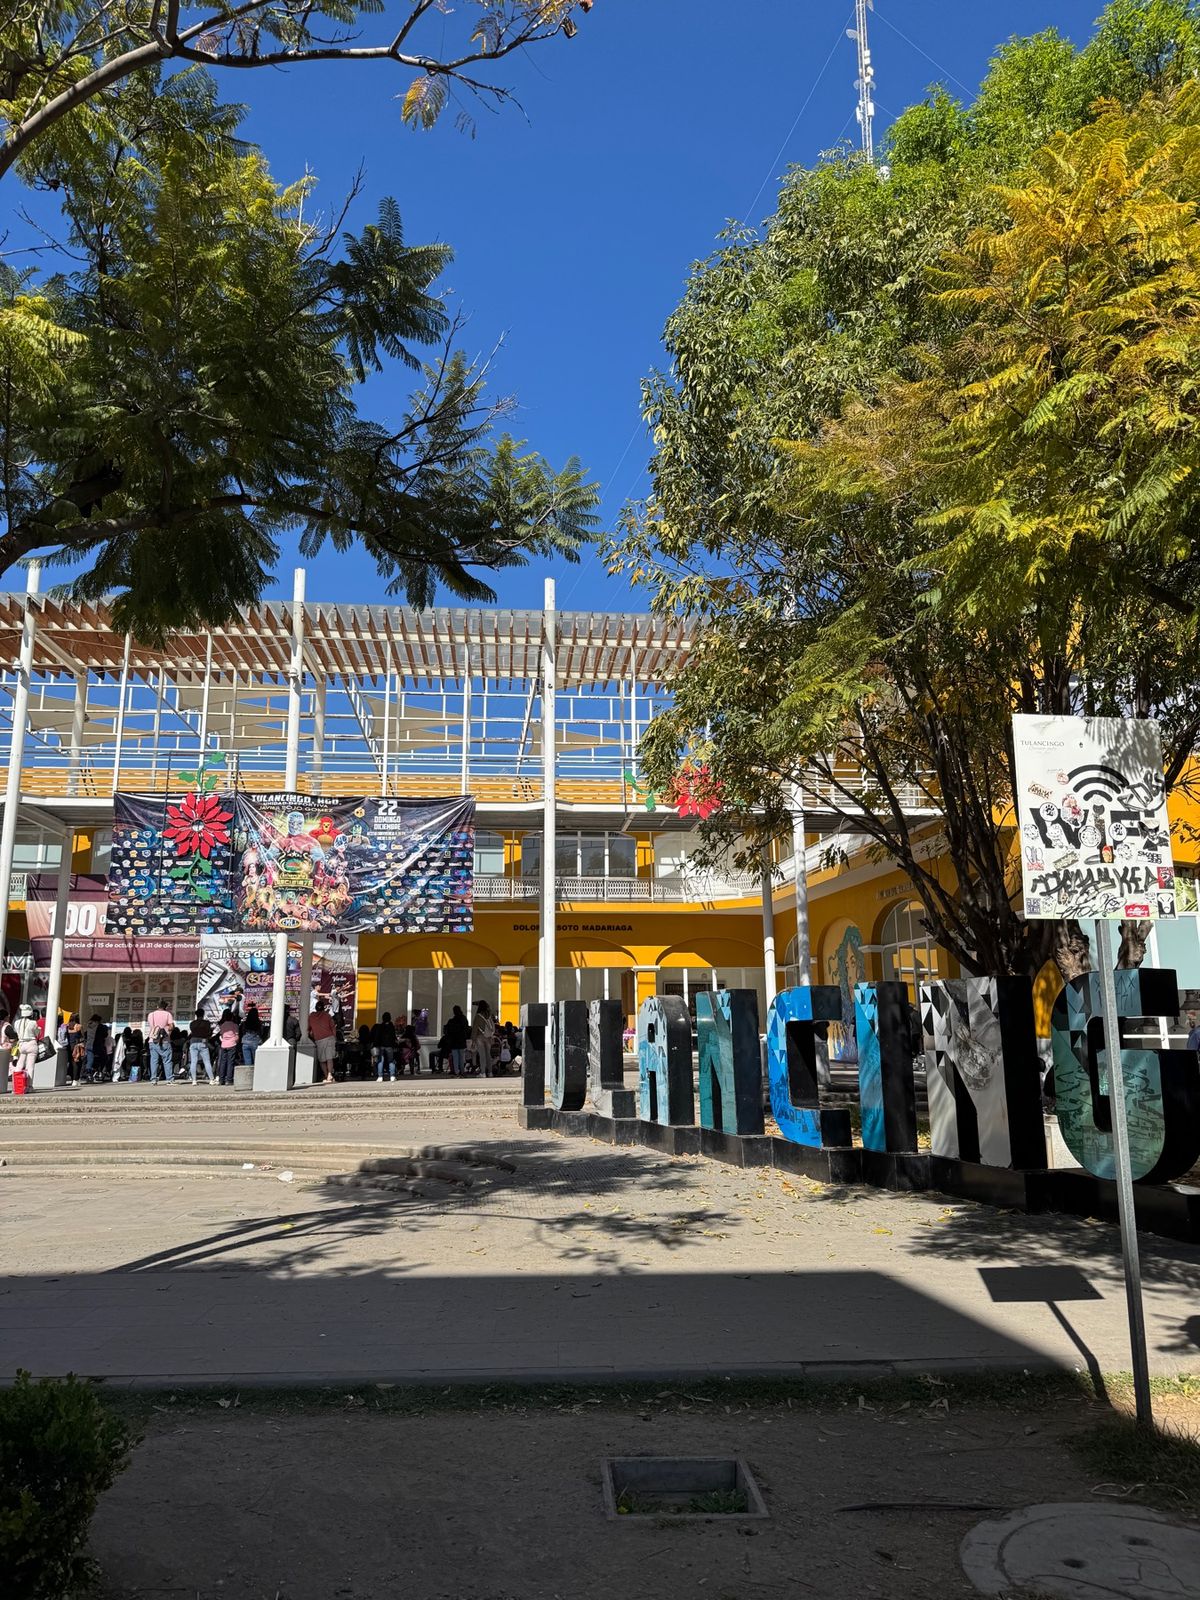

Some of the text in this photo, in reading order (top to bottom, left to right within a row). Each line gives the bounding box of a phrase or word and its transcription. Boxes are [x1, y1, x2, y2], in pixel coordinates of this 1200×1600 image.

[377, 800, 398, 816] 22
[556, 924, 579, 932] SOTO
[582, 924, 633, 932] MADARIAGA
[206, 949, 250, 959] Talleres
[253, 949, 269, 958] de
